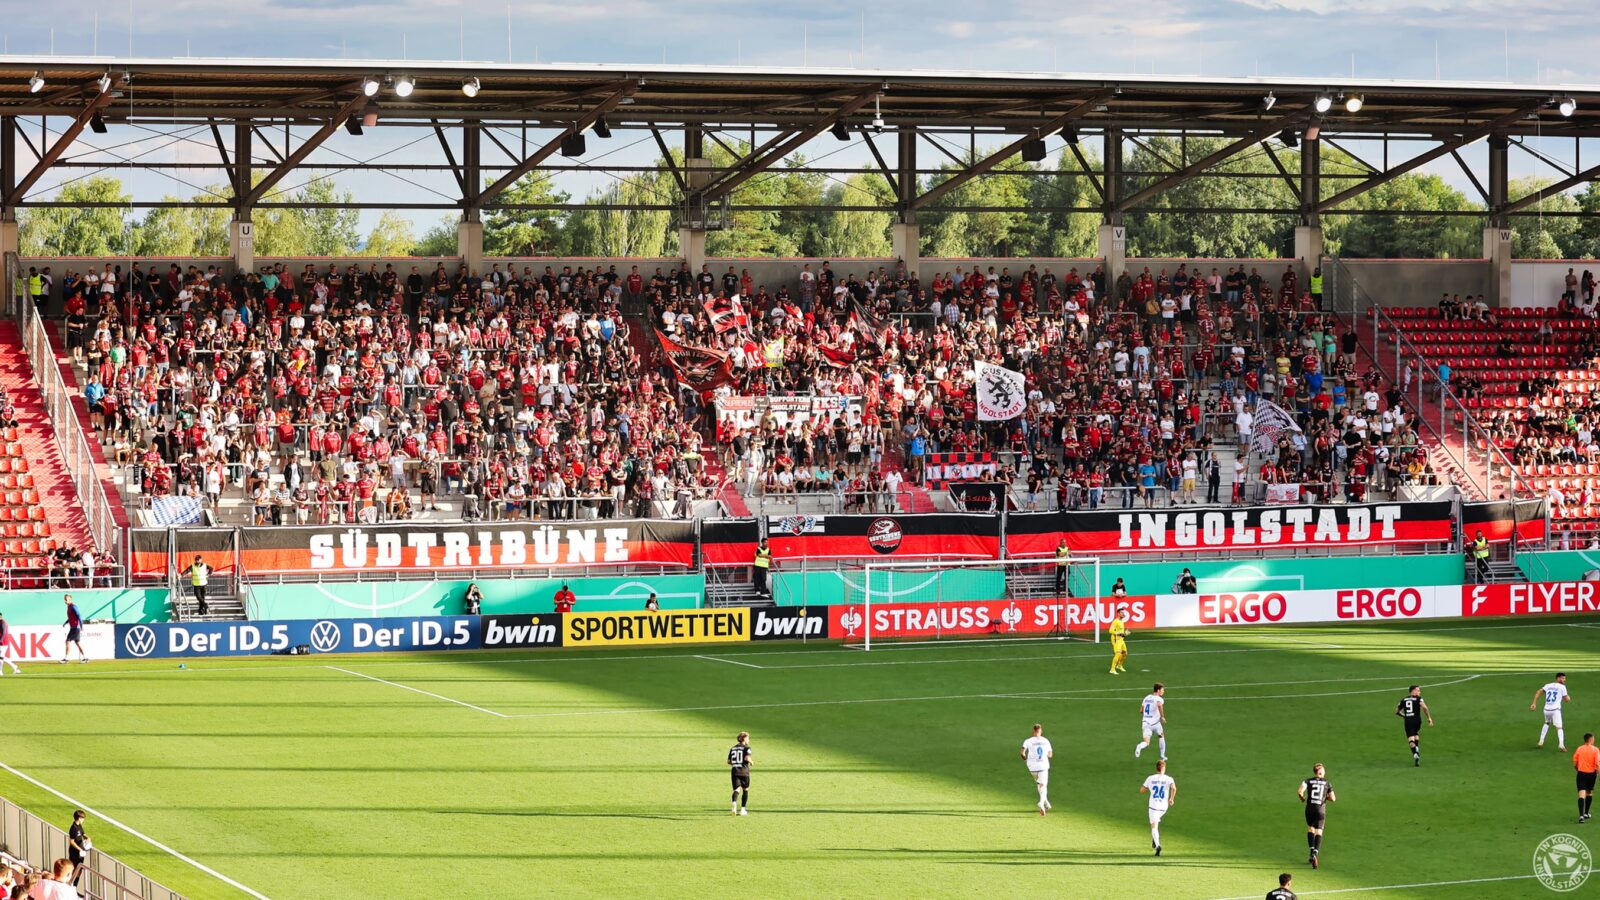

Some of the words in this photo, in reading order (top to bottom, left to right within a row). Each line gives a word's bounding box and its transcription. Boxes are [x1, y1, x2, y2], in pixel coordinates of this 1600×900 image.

[242, 225, 250, 235] U
[1115, 229, 1123, 238] V
[1500, 231, 1510, 241] W
[979, 401, 1022, 418] INGOLSTADT
[1118, 506, 1401, 548] INGOLSTADT
[309, 525, 629, 568] SÜDTRIBÜNE
[1199, 592, 1287, 623] ERGO
[1336, 587, 1422, 619] ERGO
[1509, 582, 1600, 613] FLYER
[754, 609, 823, 636] bwin
[874, 606, 990, 631] STRAUSS
[1034, 601, 1146, 626] STRAUSS
[168, 627, 222, 653] Der
[229, 624, 289, 651] ID.5
[353, 622, 405, 648] Der
[411, 619, 470, 646] ID.5
[485, 616, 556, 645] bwin
[570, 612, 743, 641] SPORTWETTEN
[1144, 703, 1151, 715] 4
[1405, 700, 1413, 713] 9
[1546, 691, 1558, 702] 23
[731, 750, 743, 764] 20
[1036, 746, 1043, 760] 9
[1152, 785, 1165, 799] 26
[1311, 784, 1324, 800] 21
